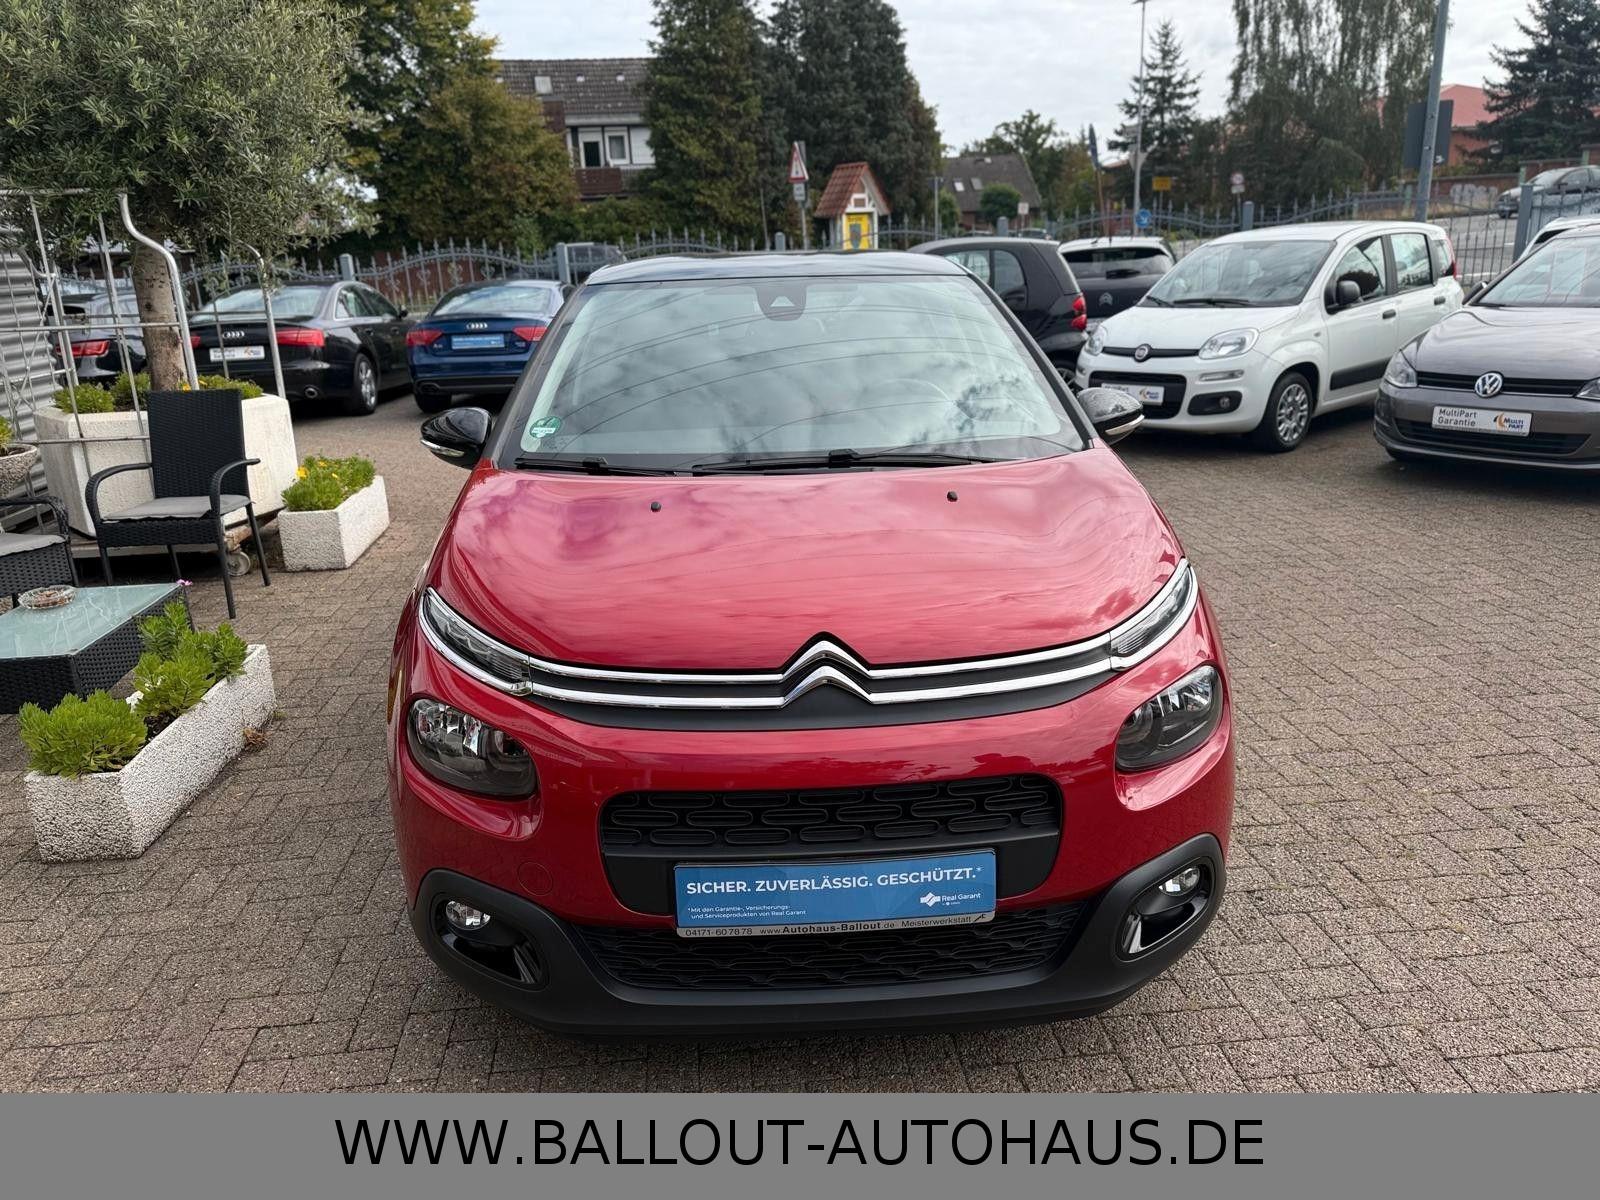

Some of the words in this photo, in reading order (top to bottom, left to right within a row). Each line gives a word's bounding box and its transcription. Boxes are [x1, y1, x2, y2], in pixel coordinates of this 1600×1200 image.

[1439, 408, 1477, 418] MultiPart
[1438, 416, 1476, 427] Garantie
[686, 881, 751, 895] SICHER.
[755, 875, 873, 892] ZUVERLÄSSIG.
[958, 892, 981, 901] Garant
[704, 911, 758, 920] Serviceprodukten
[901, 916, 972, 928] Meisterwerkstatt
